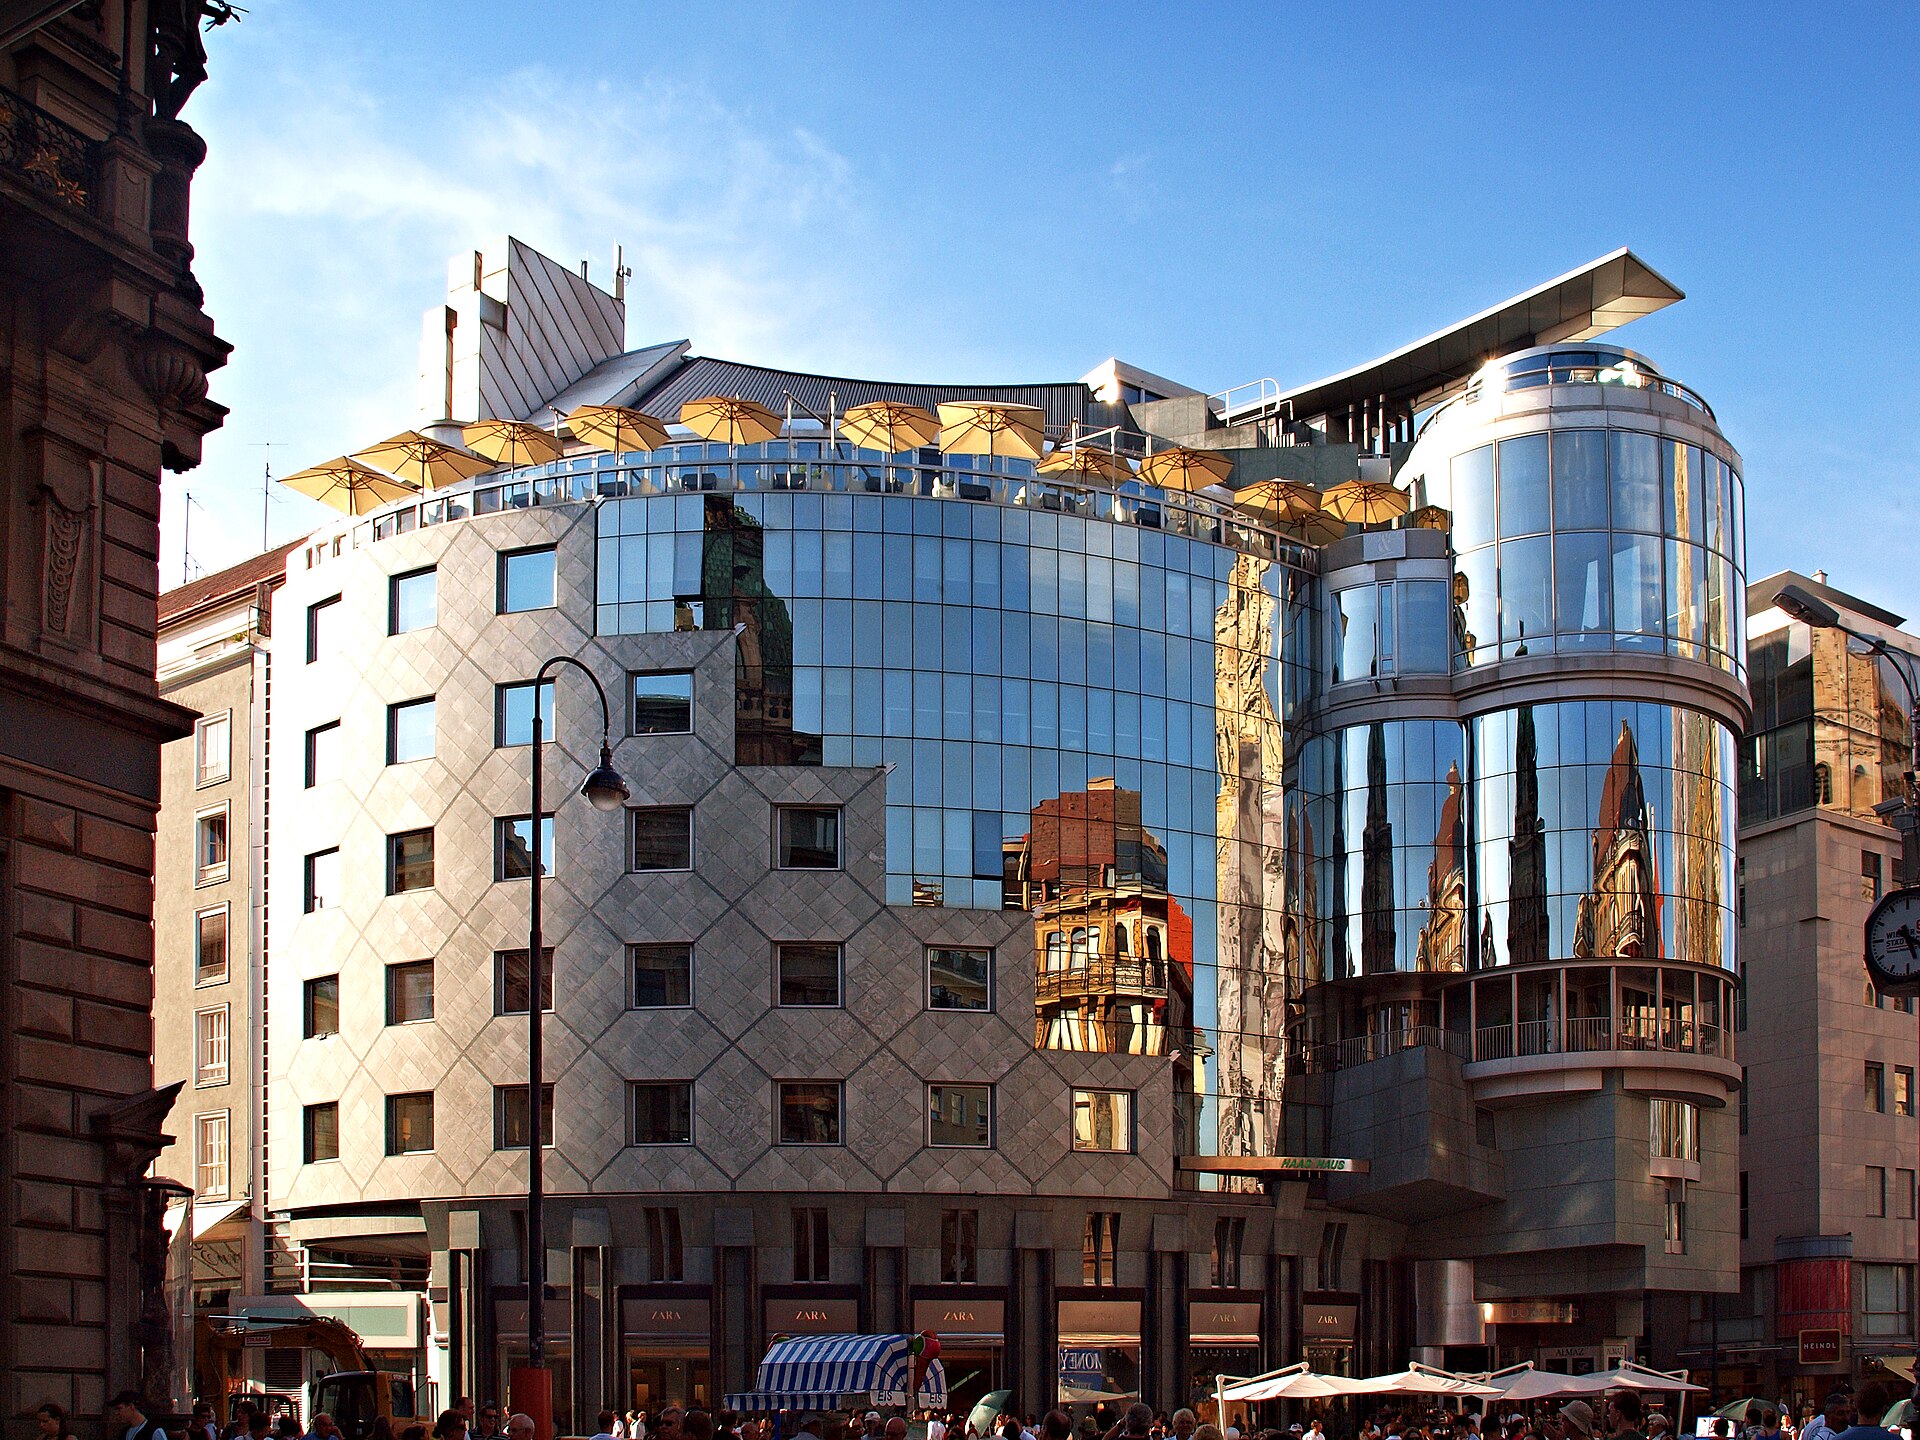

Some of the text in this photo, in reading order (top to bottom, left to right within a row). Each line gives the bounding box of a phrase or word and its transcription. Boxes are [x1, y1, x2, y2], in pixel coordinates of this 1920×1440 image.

[1281, 1159, 1345, 1169] HAAS HAUS
[651, 1311, 681, 1320] ZARA
[795, 1311, 828, 1320] ZARA
[943, 1311, 975, 1321] ZARA
[1211, 1313, 1237, 1322] ZARA
[1317, 1315, 1338, 1324] ZARA
[1555, 1347, 1585, 1356] ALMAZ
[877, 1390, 893, 1401] EIS
[929, 1393, 943, 1404] EIS
